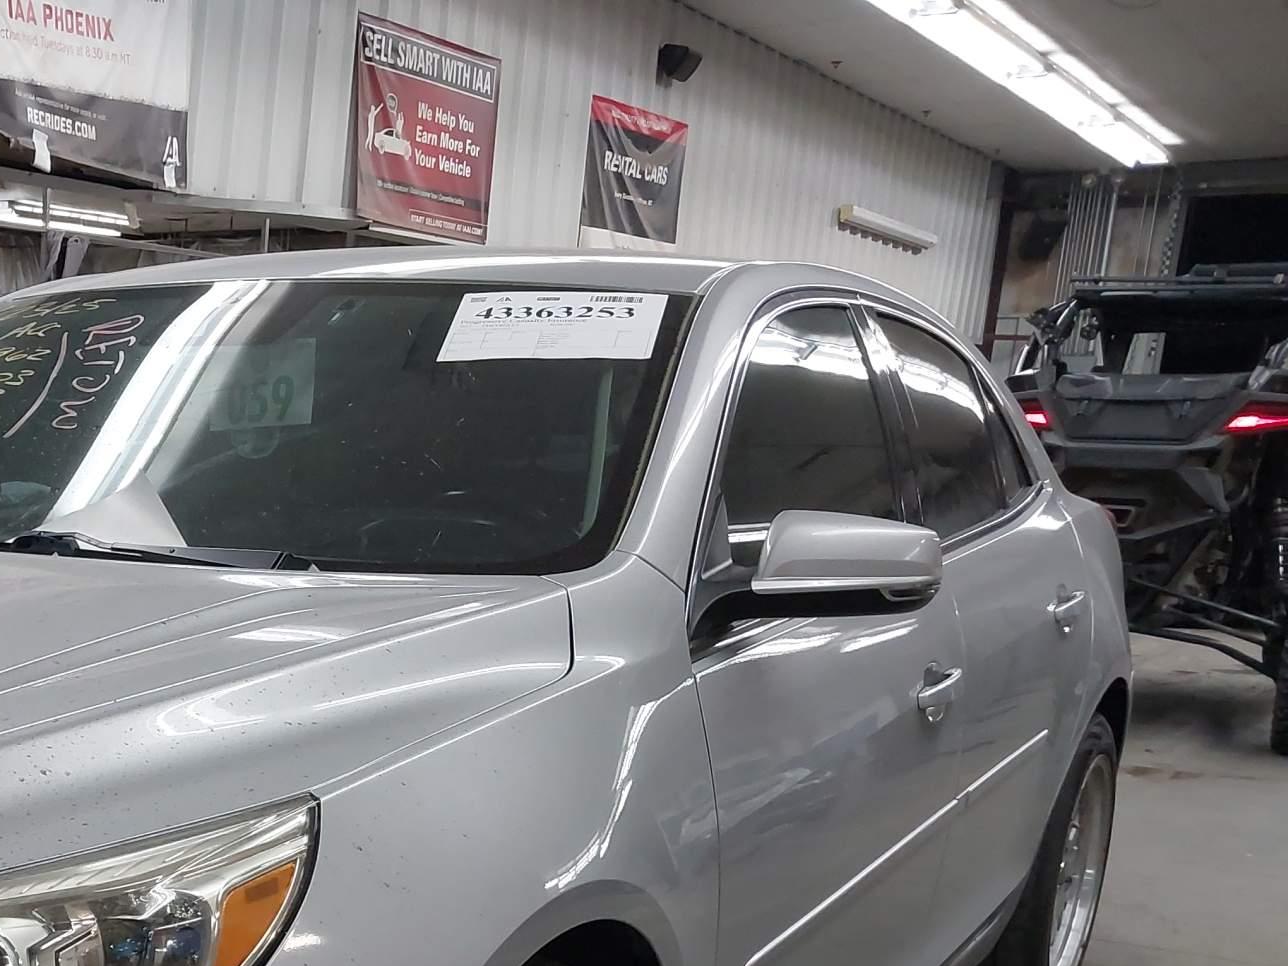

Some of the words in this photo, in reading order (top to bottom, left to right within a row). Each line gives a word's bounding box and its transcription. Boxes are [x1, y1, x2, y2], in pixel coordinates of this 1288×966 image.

[7, 0, 38, 27] IAA
[42, 3, 115, 42] PHOENIX
[364, 30, 395, 65] SELL
[396, 40, 441, 79] SMART
[441, 55, 471, 89] WITH
[472, 66, 492, 96] IAA
[27, 106, 97, 141] RECRIDES.COM
[418, 101, 433, 122] We
[434, 106, 456, 132] Help
[458, 113, 475, 134] You
[415, 125, 438, 147] Earn
[439, 131, 464, 154] More
[465, 140, 481, 158] For
[414, 148, 437, 170] Your
[438, 154, 472, 178] Vehicle
[603, 150, 642, 180] RENTAL
[644, 163, 669, 186] CARS
[475, 306, 636, 319] 43363253
